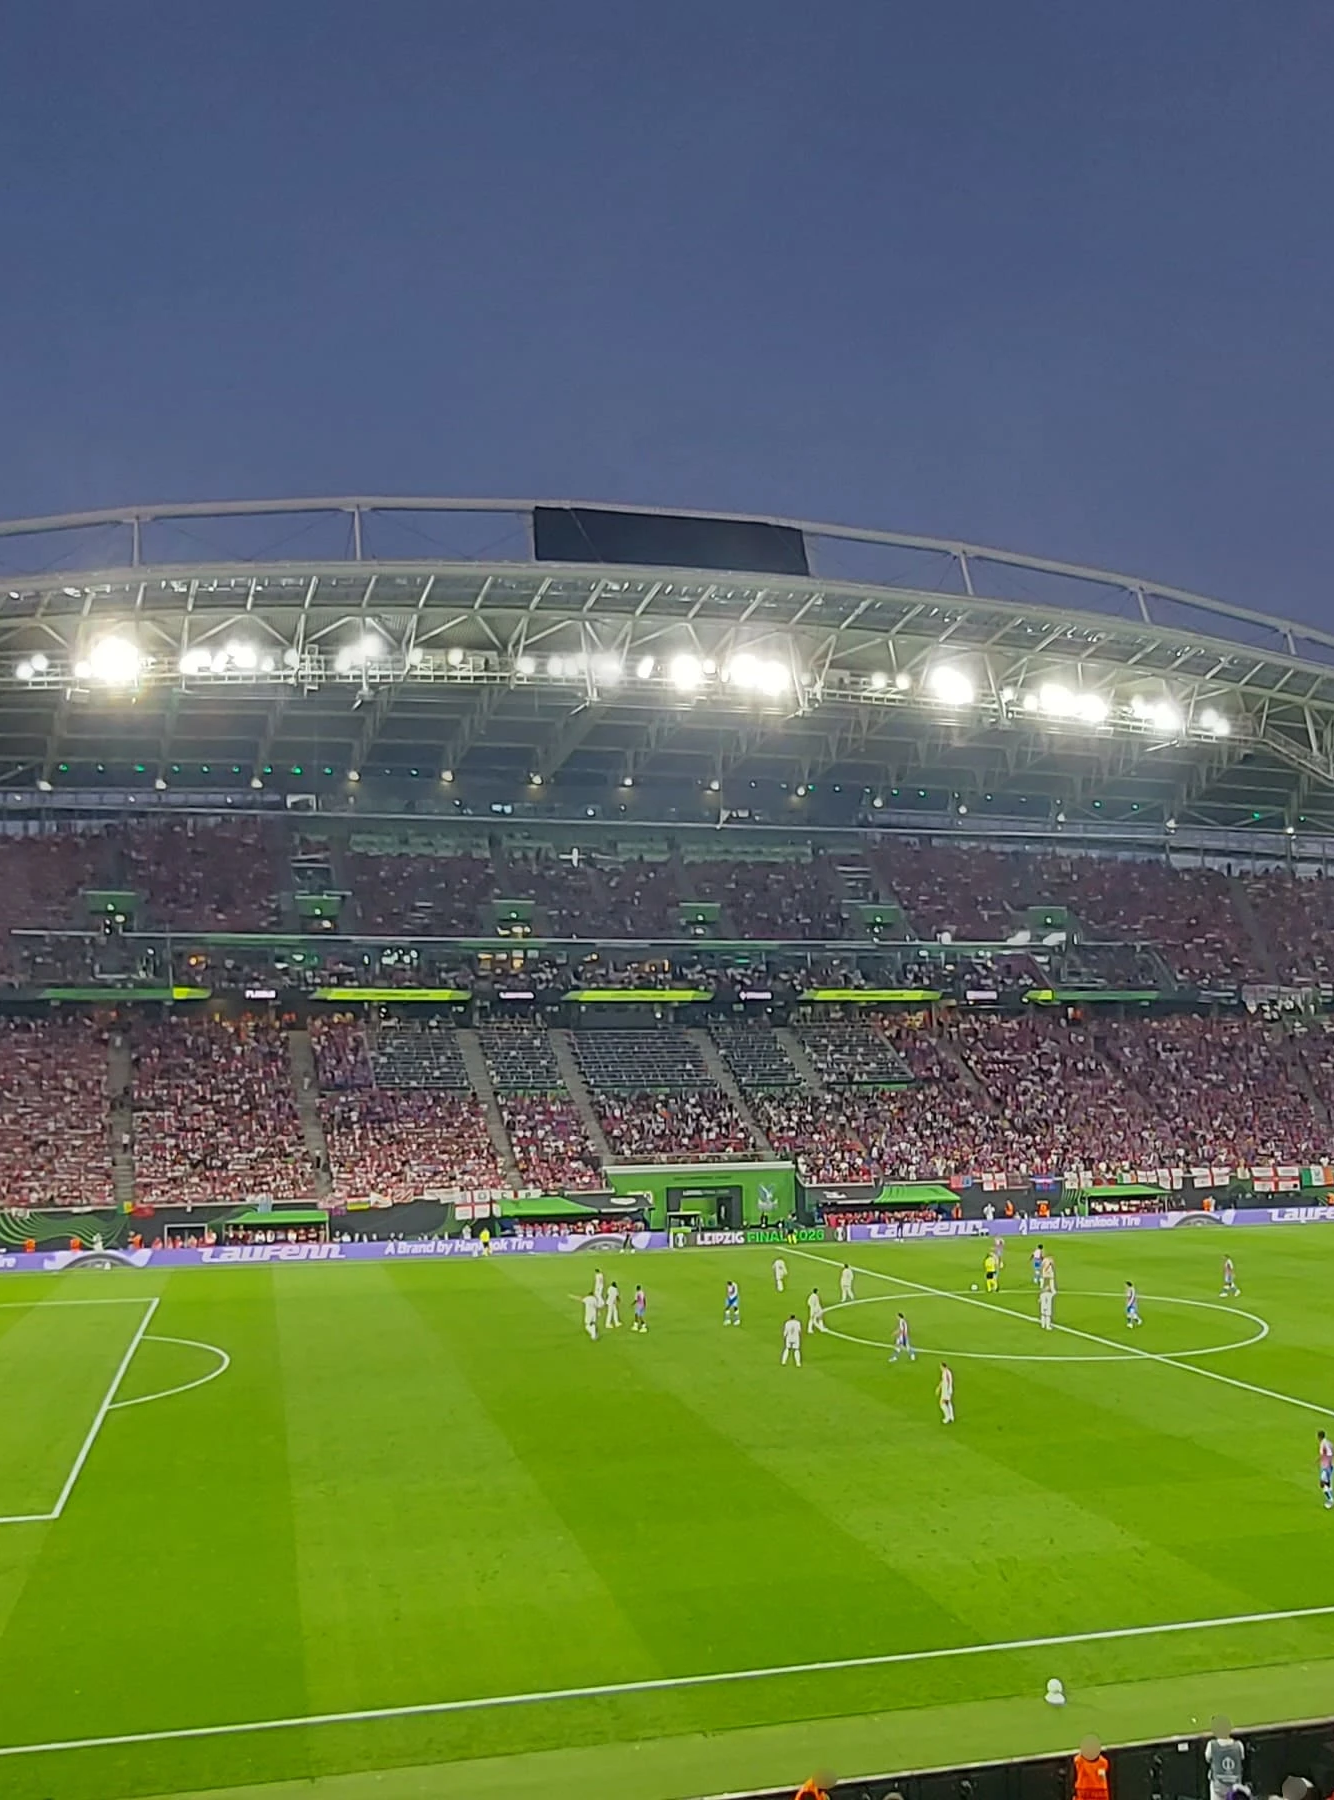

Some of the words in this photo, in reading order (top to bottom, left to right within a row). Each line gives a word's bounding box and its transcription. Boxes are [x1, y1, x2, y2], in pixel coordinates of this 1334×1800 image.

[1029, 1218, 1060, 1231] Brand
[1061, 1216, 1075, 1231] by
[696, 1231, 745, 1245] LEIPZIG
[746, 1230, 787, 1243] FINAL
[384, 1242, 396, 1255] A
[398, 1241, 432, 1255] Brand
[434, 1240, 453, 1255] by
[510, 1238, 534, 1250] Tire
